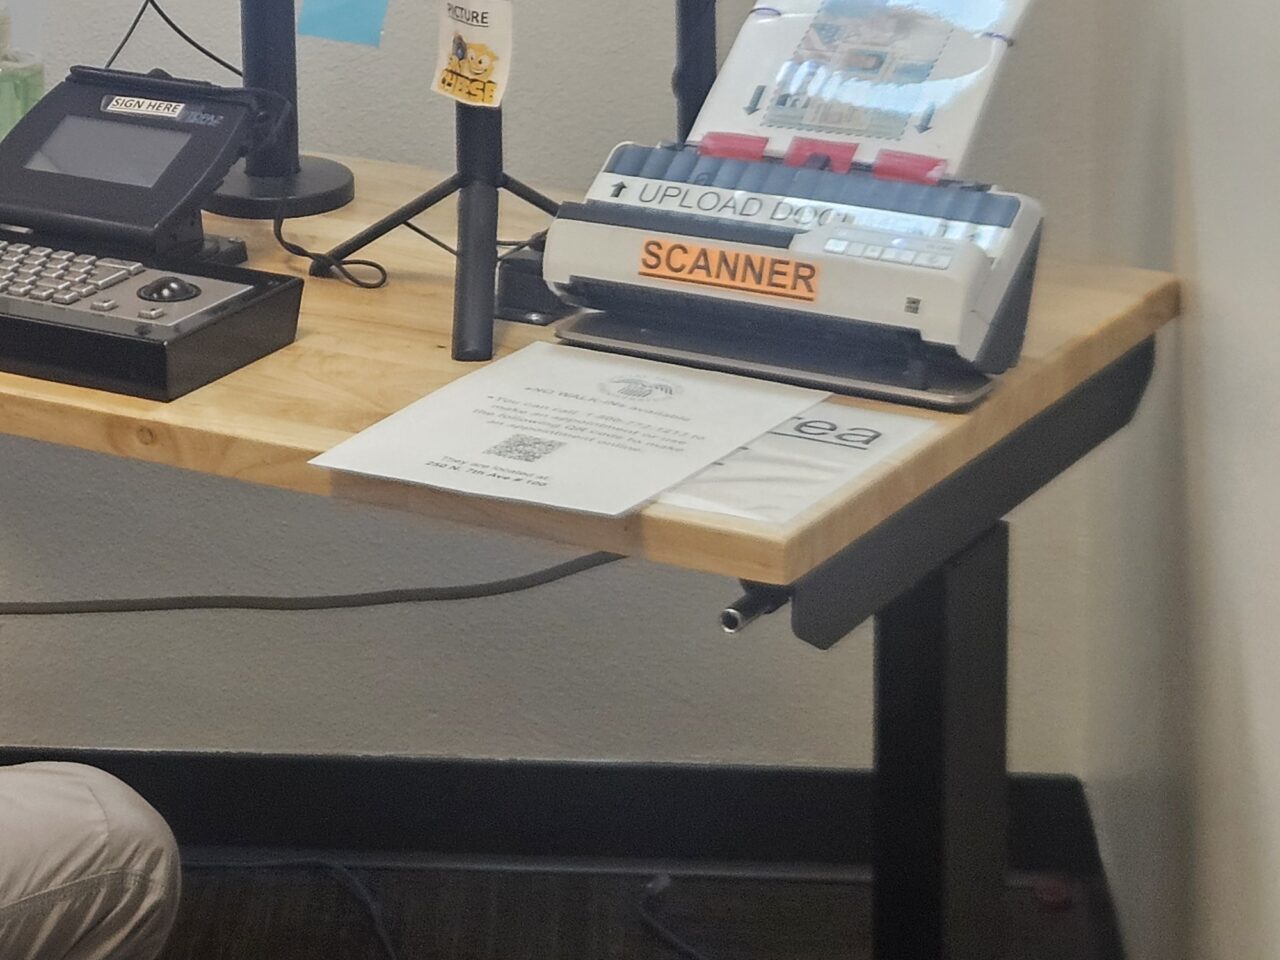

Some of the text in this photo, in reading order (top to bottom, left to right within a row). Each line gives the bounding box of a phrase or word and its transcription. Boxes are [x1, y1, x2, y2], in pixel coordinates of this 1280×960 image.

[447, 2, 489, 24] PICTURE
[113, 98, 181, 113] SIGN HERE
[638, 183, 763, 217] UPLOAD
[641, 240, 817, 293] SCANNER
